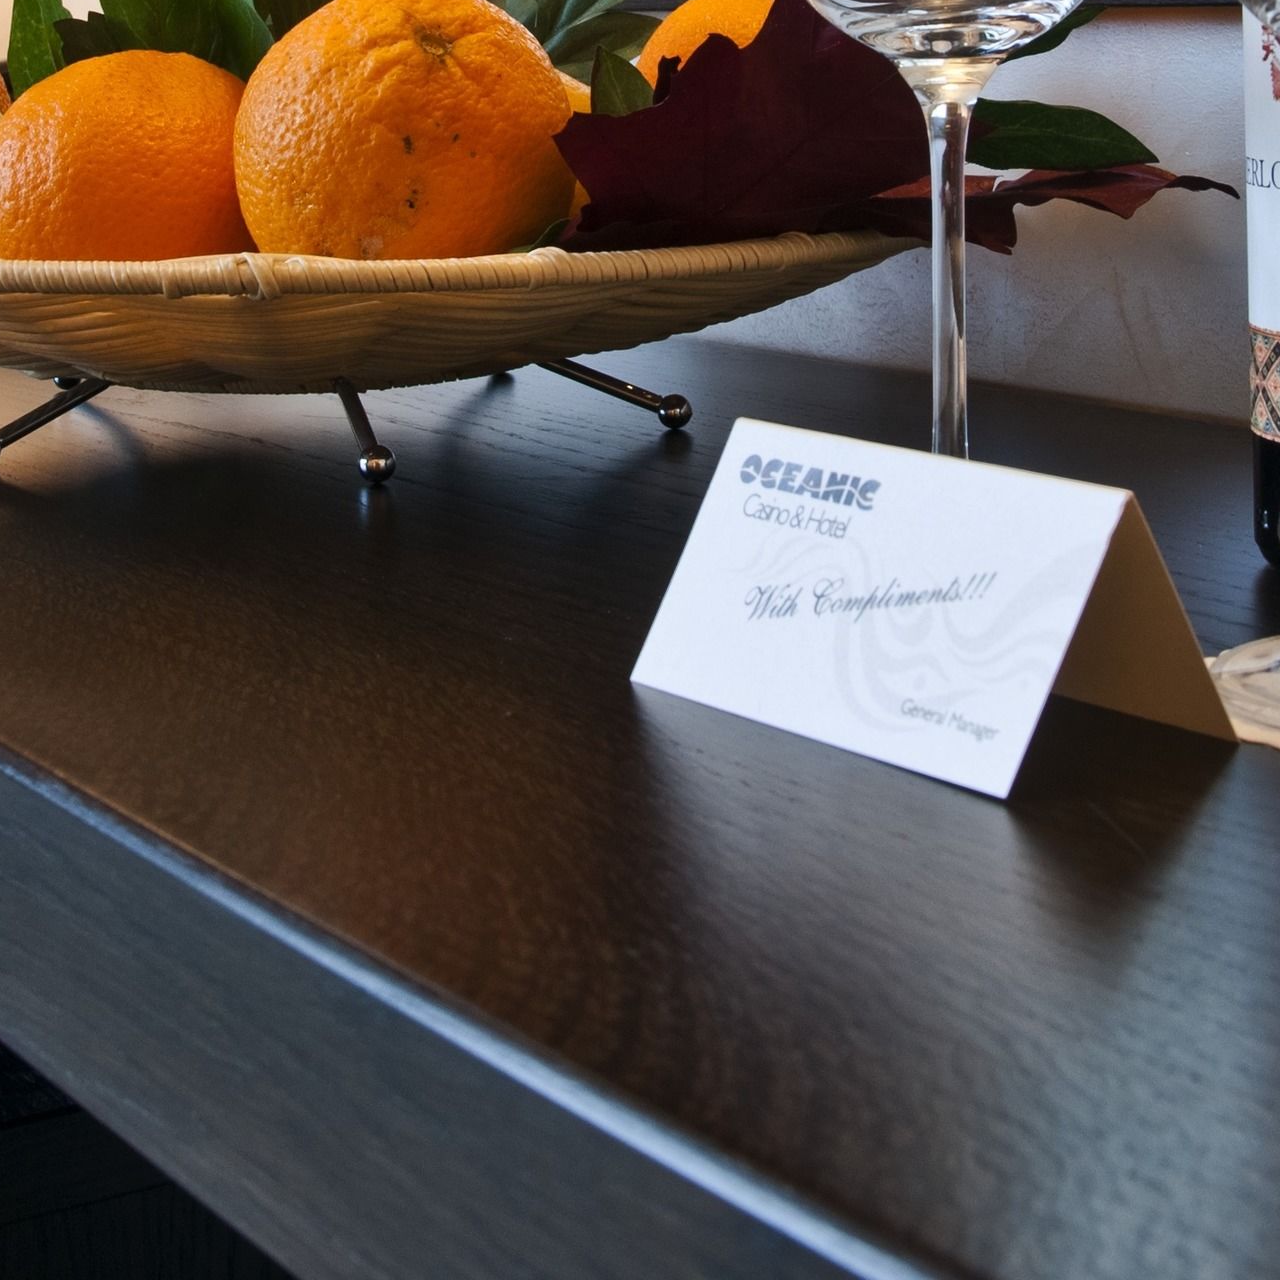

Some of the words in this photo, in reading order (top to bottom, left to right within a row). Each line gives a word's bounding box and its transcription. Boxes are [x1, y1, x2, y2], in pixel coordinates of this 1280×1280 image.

[740, 453, 881, 511] OCEANIC
[743, 492, 790, 526] Casino
[789, 505, 805, 528] &
[805, 506, 852, 539] Hotel
[744, 582, 803, 621] With
[813, 570, 998, 624] Compliments!!!
[947, 711, 1001, 743] Manager
